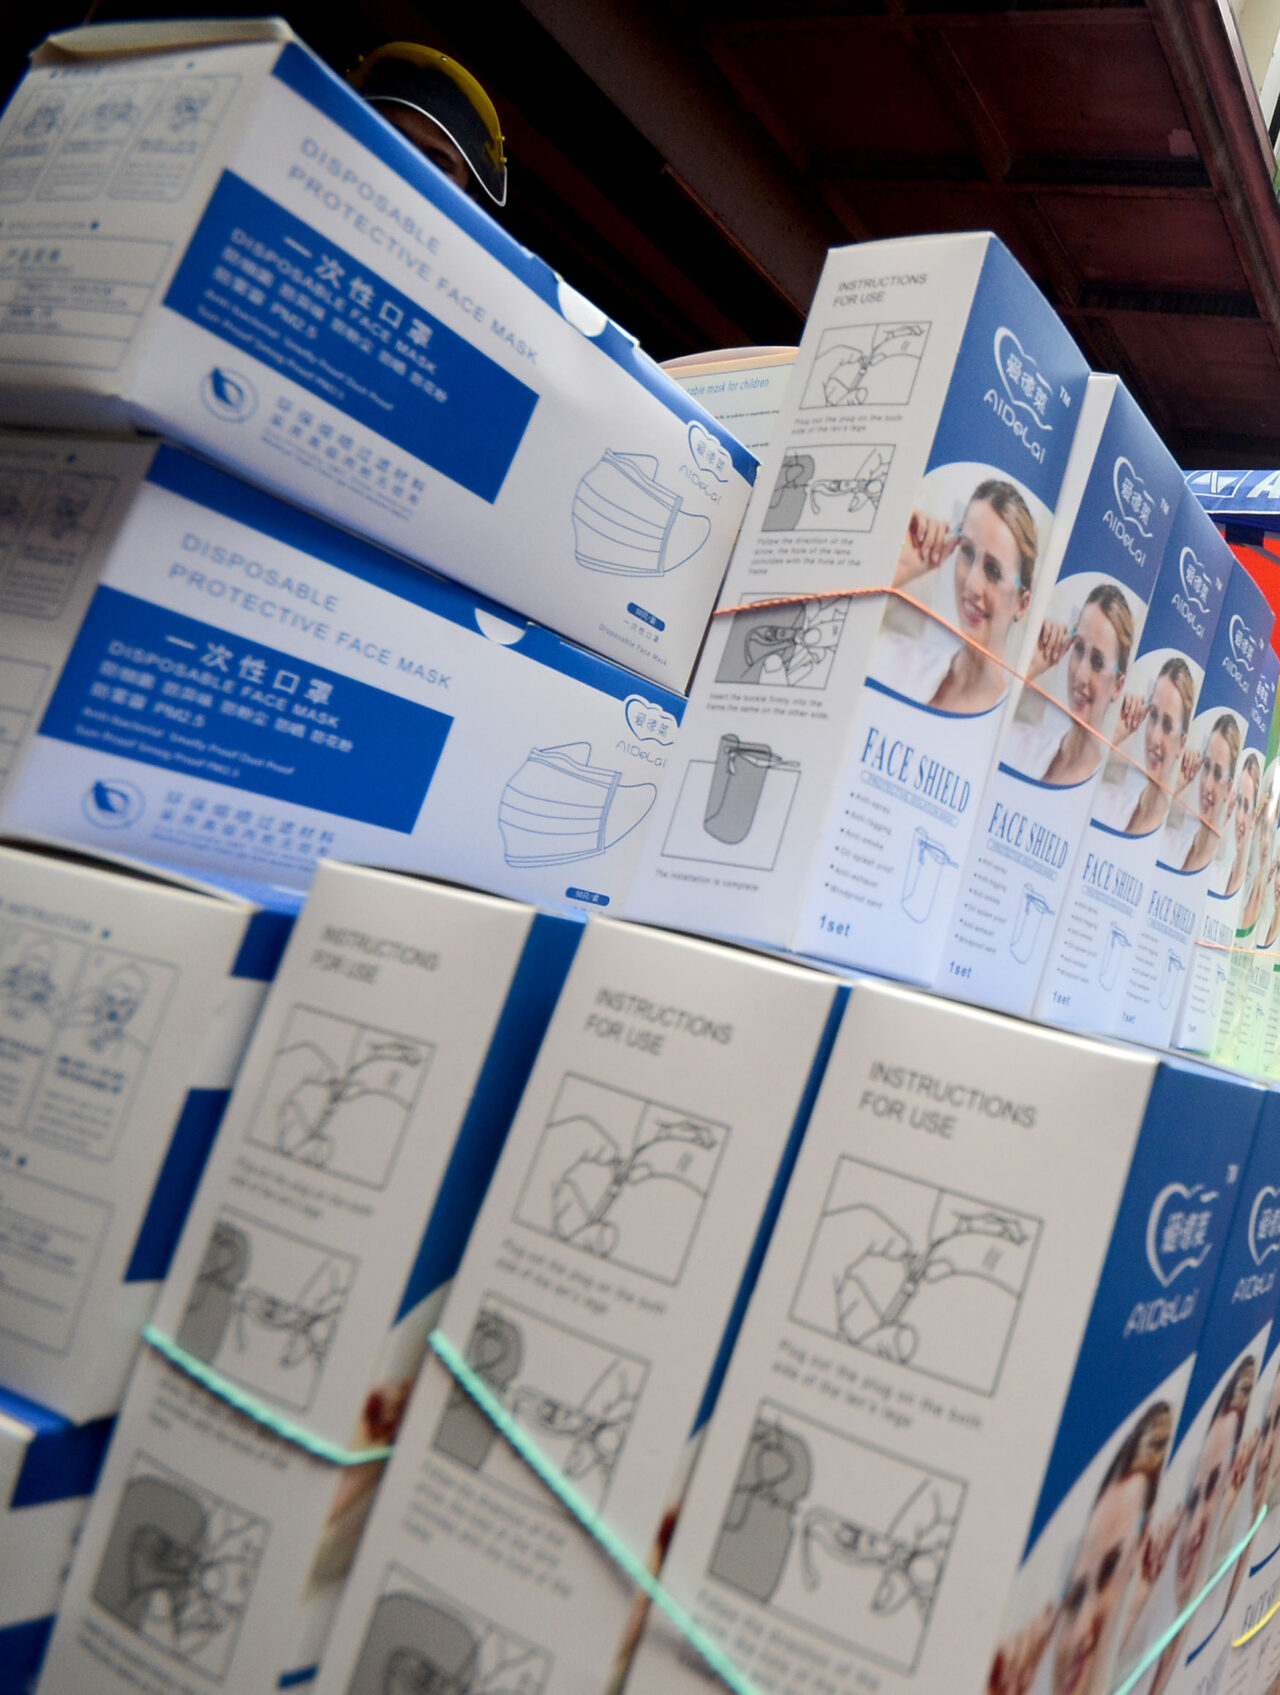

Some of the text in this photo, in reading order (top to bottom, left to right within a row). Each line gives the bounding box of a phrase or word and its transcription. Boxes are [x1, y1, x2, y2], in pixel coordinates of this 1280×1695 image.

[301, 138, 441, 255] DISPOSABLE
[278, 226, 435, 351] 一次性口罩
[289, 166, 539, 364] PROTECTIVE FACE MASK
[837, 274, 928, 293] INSTRUCTIONS
[229, 226, 438, 375] DISPOSABLE FACE MASK
[833, 291, 885, 308] FOR USE
[740, 377, 770, 390] children
[180, 532, 339, 612] DISPOSABLE
[169, 562, 453, 689] PROTECTIVE FACE MASK
[106, 640, 340, 729] DISPOSABLE FACE MASK
[161, 625, 335, 708] 一次性口罩
[152, 701, 207, 728] PM2.5
[860, 726, 915, 783] FACE
[914, 755, 971, 814] SHIELD
[987, 802, 1028, 848] FACE
[1025, 821, 1069, 869] SHIELD
[1082, 852, 1114, 891] FACE
[1112, 867, 1145, 907] SHIELD
[1148, 890, 1174, 922] FACE
[312, 949, 380, 985] FOR USE
[321, 926, 441, 973] INSTRUCTIONS
[584, 1014, 665, 1056] FOR USE
[595, 988, 733, 1046] INSTRUCTIONS
[858, 1090, 958, 1139] FOR USE
[870, 1061, 1037, 1129] INSTRUCTIONS
